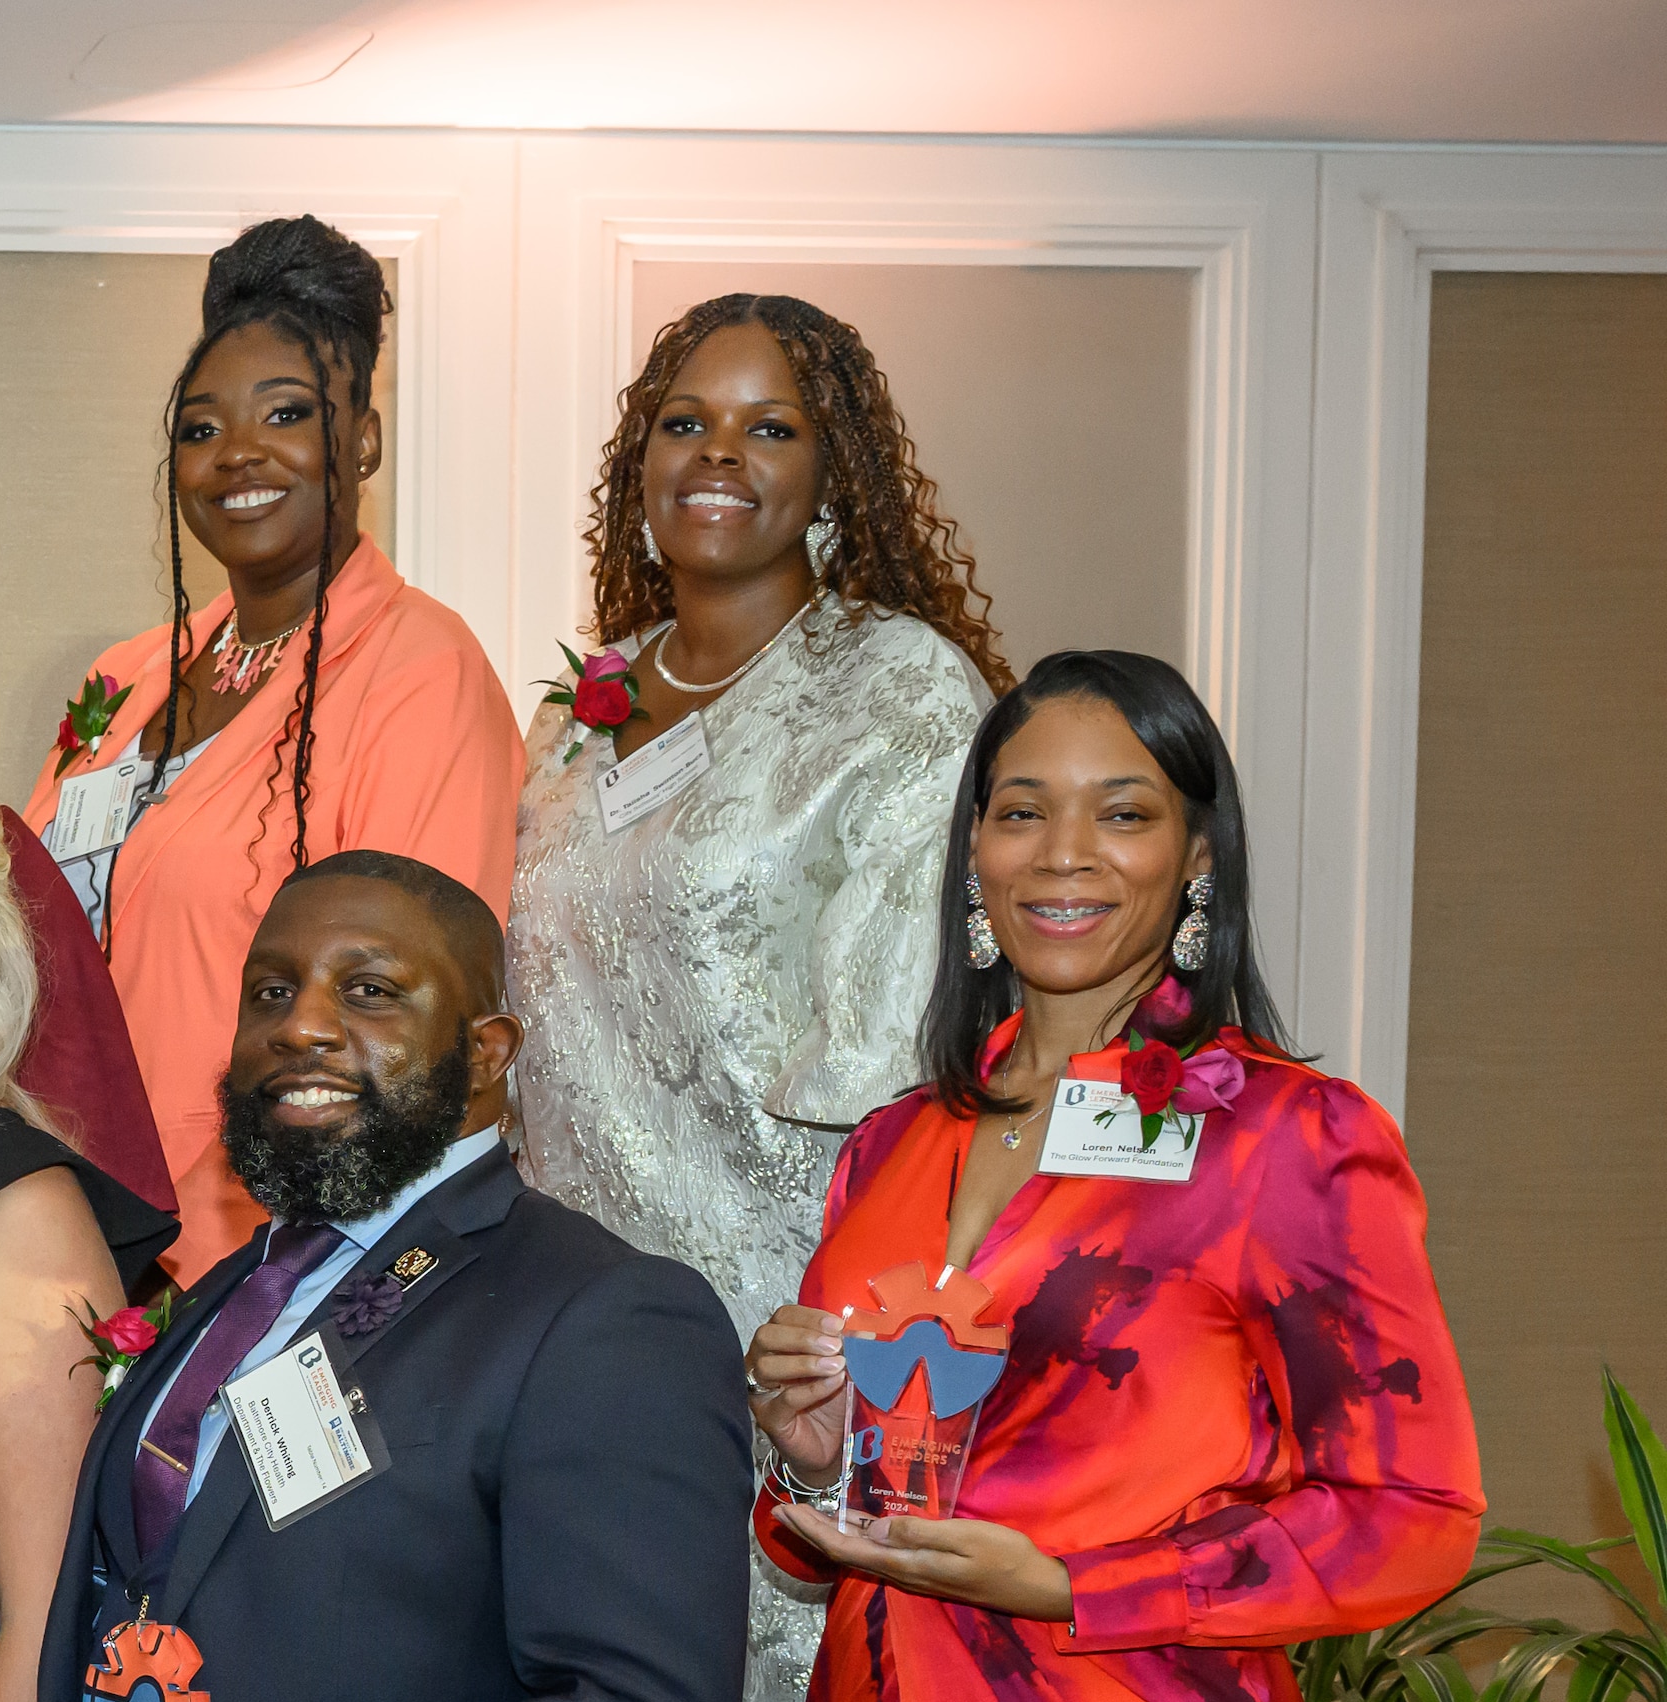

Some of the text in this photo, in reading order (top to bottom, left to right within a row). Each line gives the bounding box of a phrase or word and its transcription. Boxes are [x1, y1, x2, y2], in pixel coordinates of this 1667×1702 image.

[1050, 1152, 1184, 1168] The Glow Forward Foundation
[1082, 1143, 1157, 1155] Loren Nelson
[310, 1371, 329, 1407] LEADERS
[317, 1366, 338, 1410] EMERGING
[233, 1397, 278, 1505] Department & The Flowers
[248, 1400, 286, 1488] Baltimore City Health
[261, 1397, 296, 1479] Derrick Whiting
[335, 1429, 356, 1471] BALTIMORE
[891, 1437, 962, 1455] EMERGING
[890, 1448, 947, 1465] LEADERS
[869, 1486, 928, 1501] Loren Nelson
[884, 1501, 909, 1512] 2024
